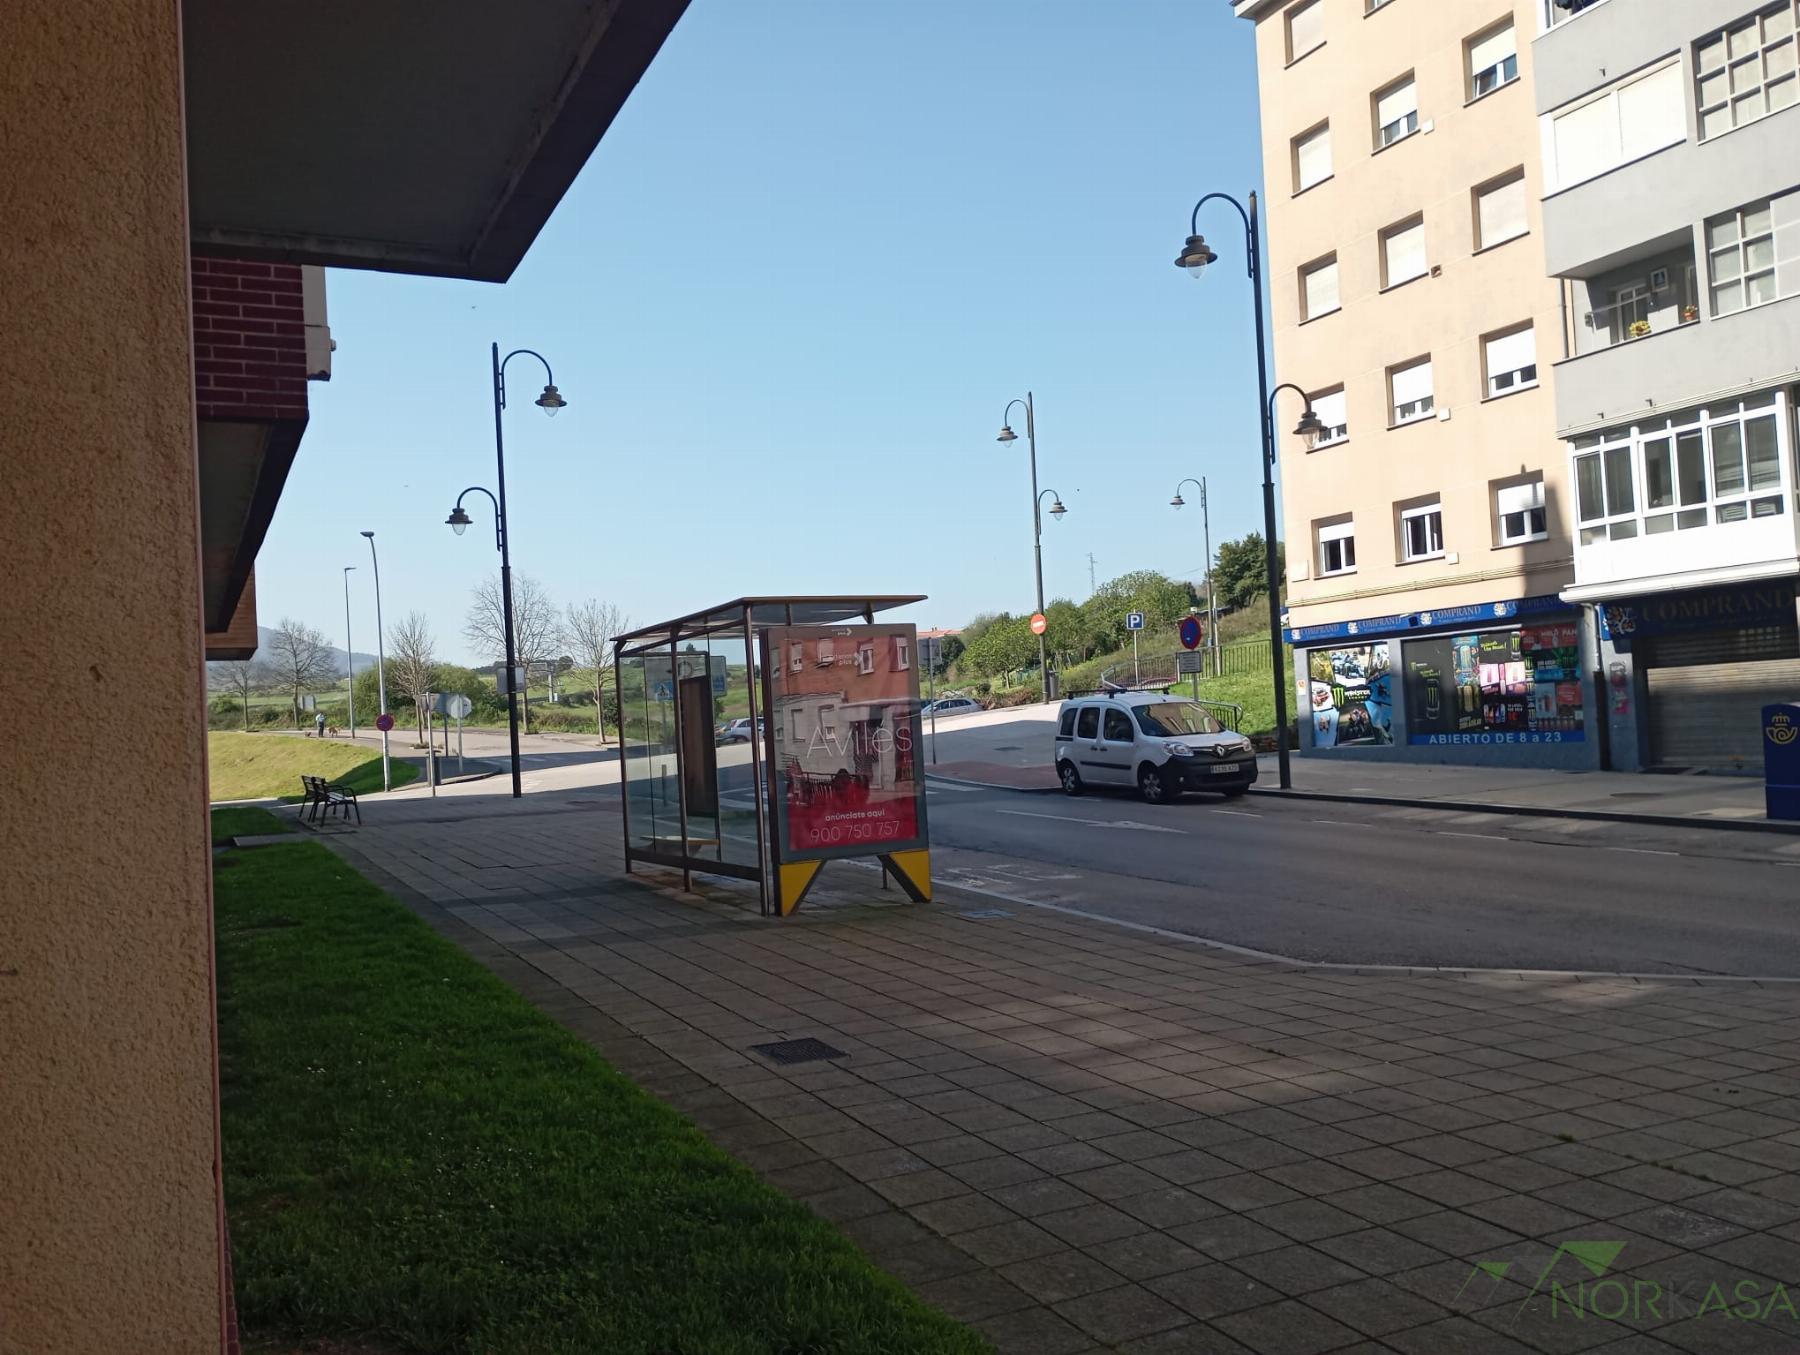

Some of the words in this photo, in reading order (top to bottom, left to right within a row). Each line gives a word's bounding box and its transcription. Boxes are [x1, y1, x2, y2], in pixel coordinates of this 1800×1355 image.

[1432, 606, 1481, 619] COMPRAND
[1642, 591, 1793, 621] COMPRAND
[1131, 616, 1140, 627] P
[1358, 616, 1402, 628] COMPRAND
[1300, 624, 1340, 635] COMPRAND
[807, 719, 912, 758] Avilés
[1429, 733, 1490, 745] ABIERTO
[1495, 732, 1514, 743] DE
[1519, 732, 1527, 743] 8
[1532, 734, 1540, 743] a
[1544, 731, 1562, 743] 23
[825, 810, 865, 821] anúnciate
[810, 826, 840, 842] 900
[845, 823, 871, 839] 750
[876, 820, 900, 836] 757
